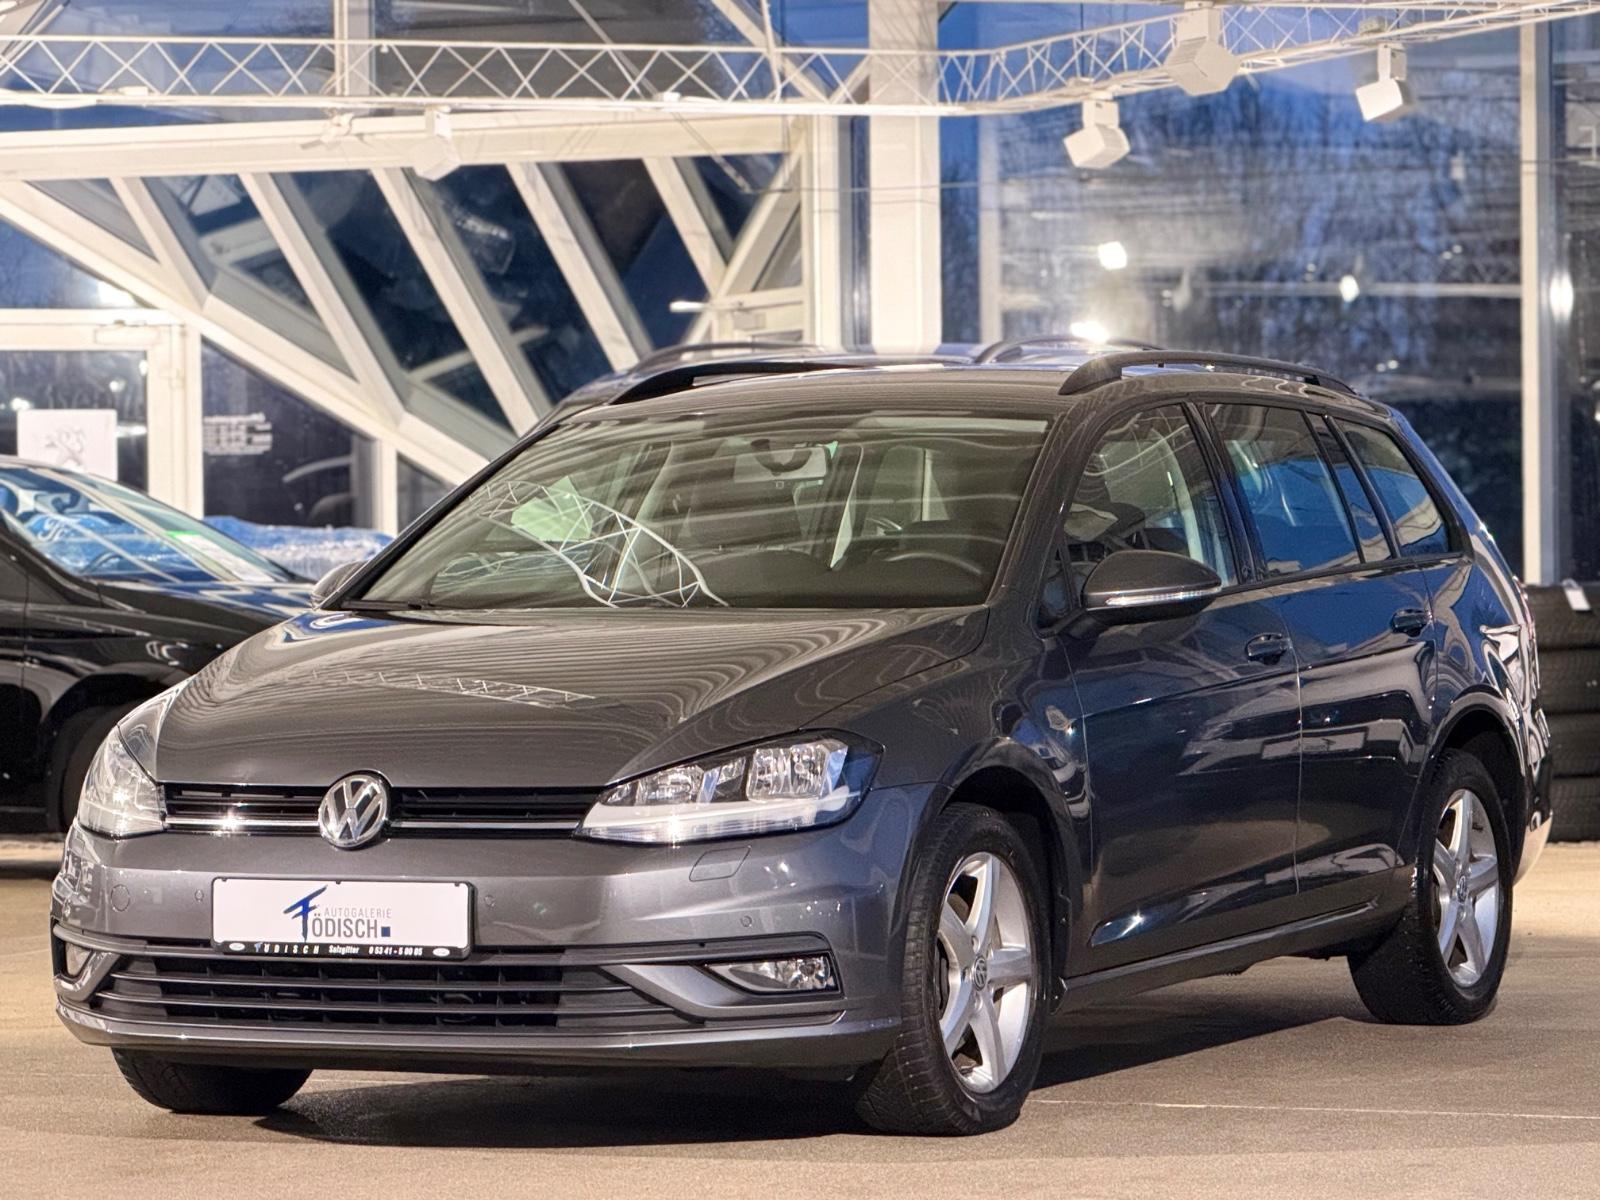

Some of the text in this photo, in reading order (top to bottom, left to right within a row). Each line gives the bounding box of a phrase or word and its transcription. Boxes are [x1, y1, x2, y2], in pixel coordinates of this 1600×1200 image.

[319, 774, 387, 847] VW
[324, 907, 392, 919] AUTOGALERIE
[328, 944, 360, 956] Salzgitter
